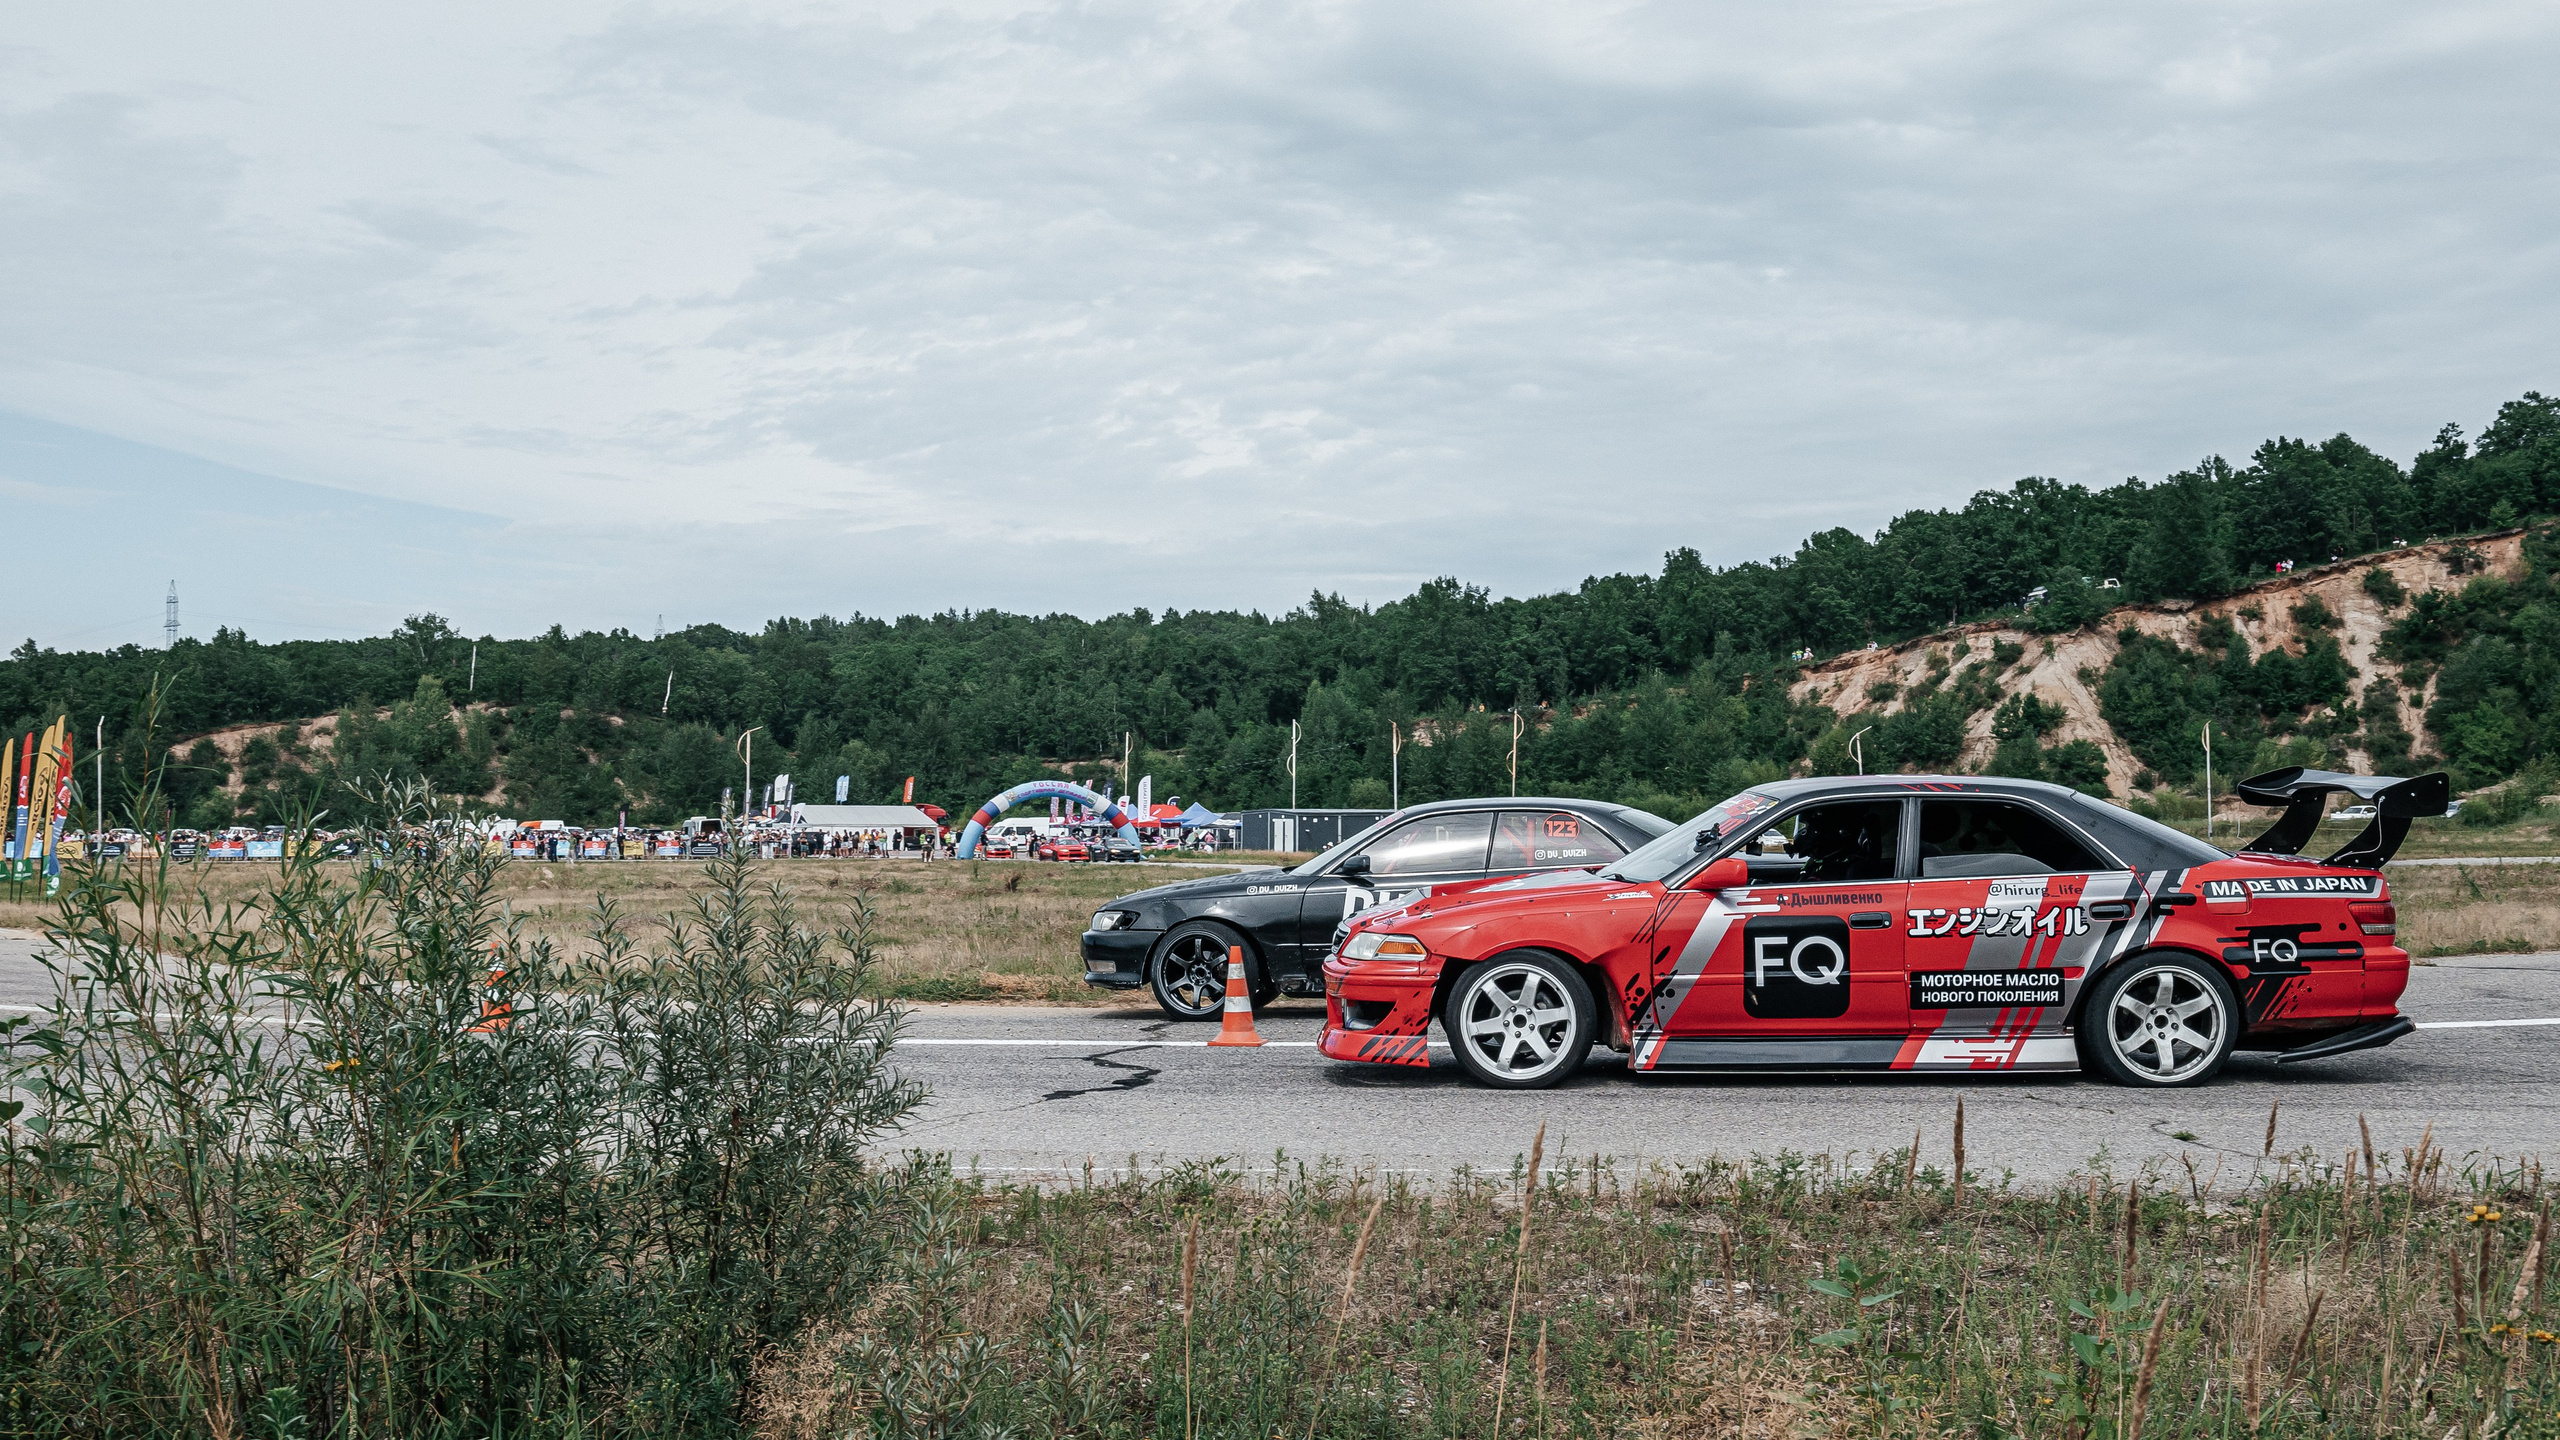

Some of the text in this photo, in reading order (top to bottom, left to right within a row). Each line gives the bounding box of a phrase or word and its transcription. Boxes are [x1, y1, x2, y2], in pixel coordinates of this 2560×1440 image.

[1546, 820, 1578, 838] 123
[1988, 883, 2084, 898] @hirurg_life
[2210, 877, 2369, 896] MADE IN JAPAN
[1776, 893, 1883, 908] А.Дышливенко
[1907, 905, 2091, 938] エンジンオイル
[2253, 938, 2299, 963] FQ
[1754, 935, 1845, 987] FQ
[1921, 974, 2060, 987] МОТОРНОЕ МАСЛО
[1921, 991, 2059, 1003] НОВОГО ПОКОЛЕНИЯ
